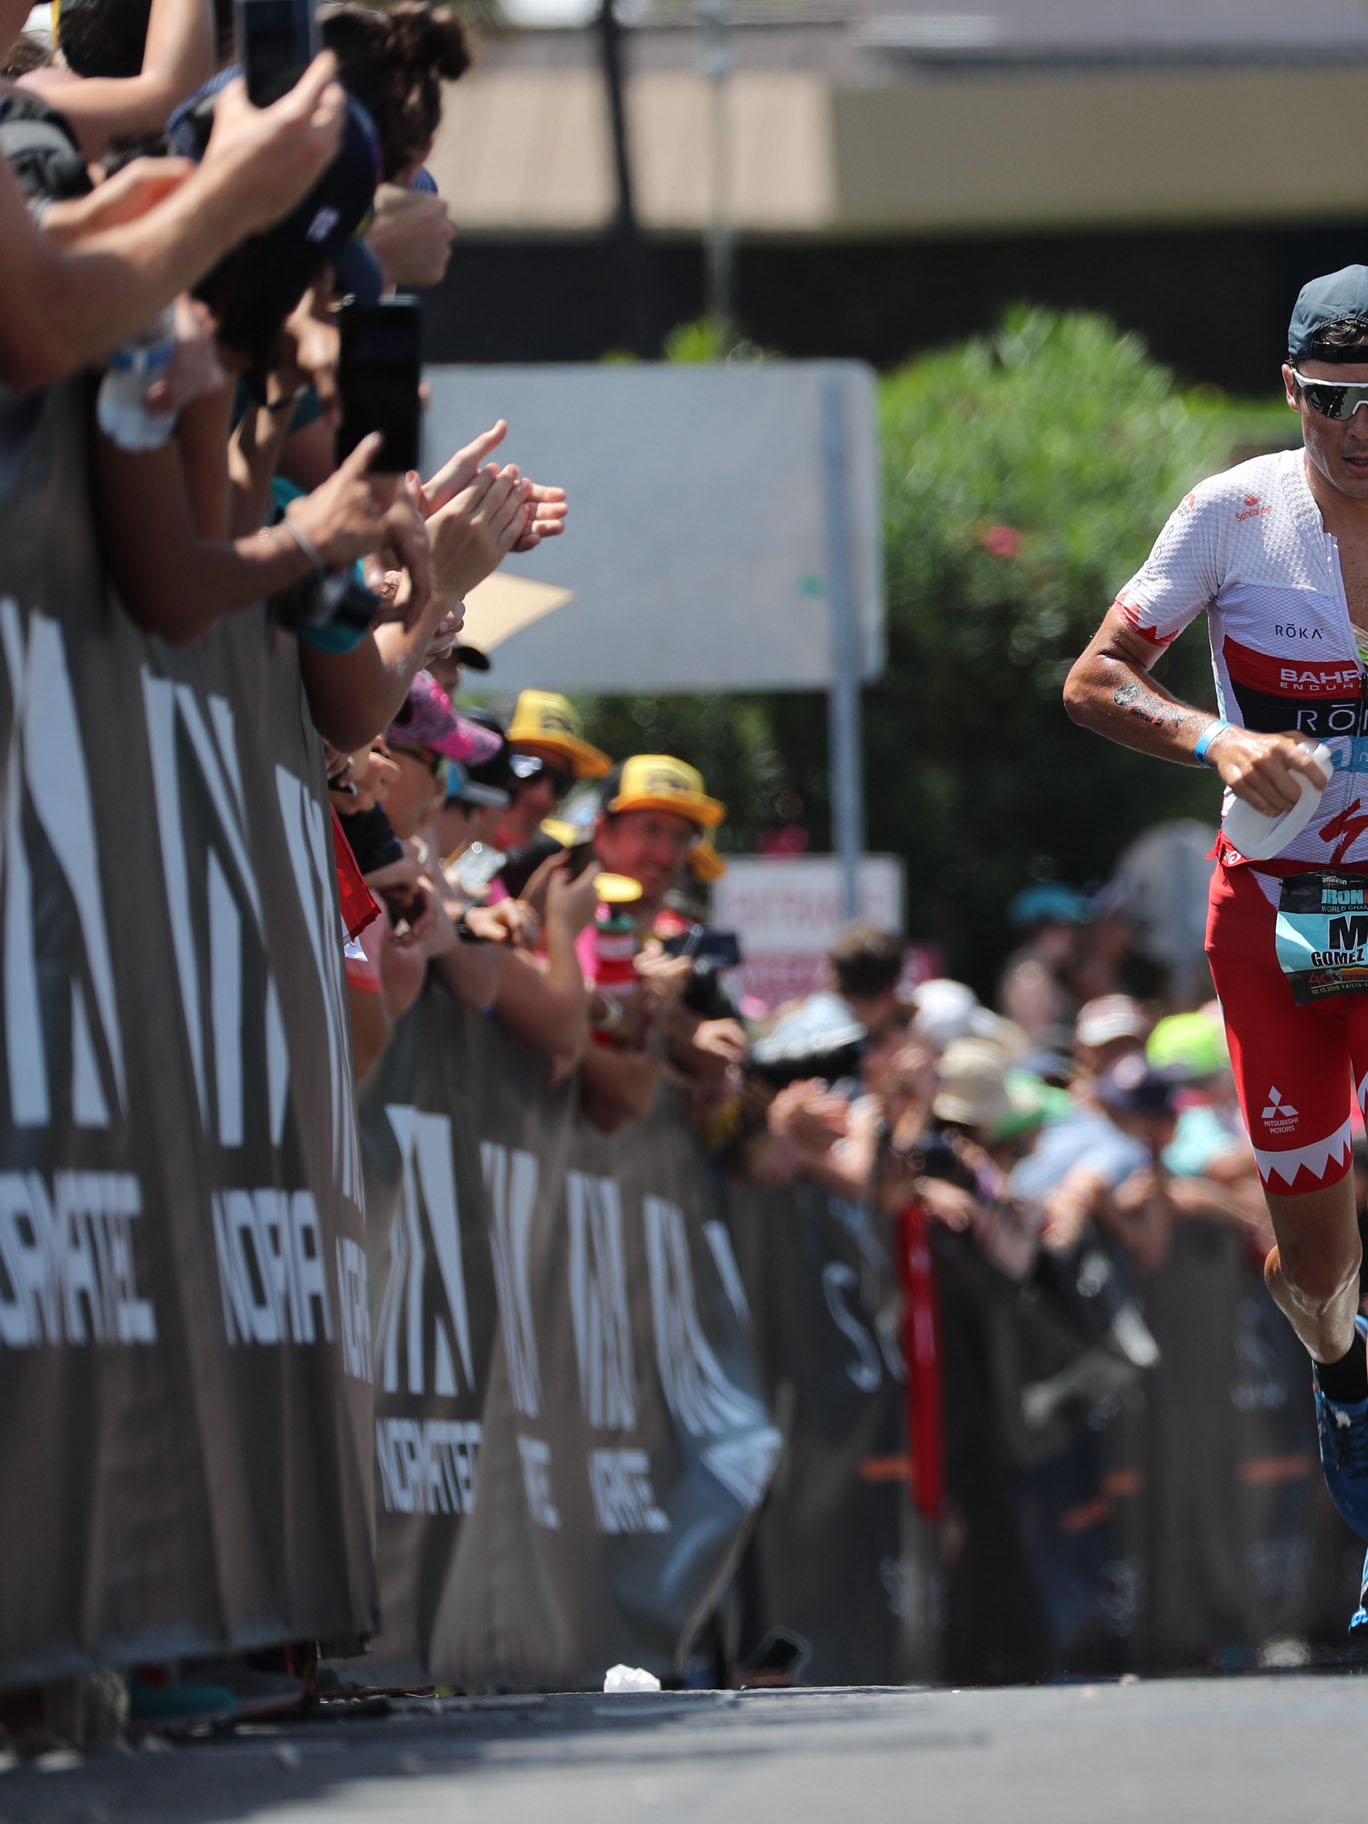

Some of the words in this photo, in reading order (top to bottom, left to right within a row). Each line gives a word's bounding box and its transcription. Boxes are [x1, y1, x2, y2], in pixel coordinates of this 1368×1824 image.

[1310, 947, 1365, 968] GOMEZ
[1263, 1117, 1299, 1127] MITSUBISHI
[1270, 1125, 1296, 1134] MOTORS
